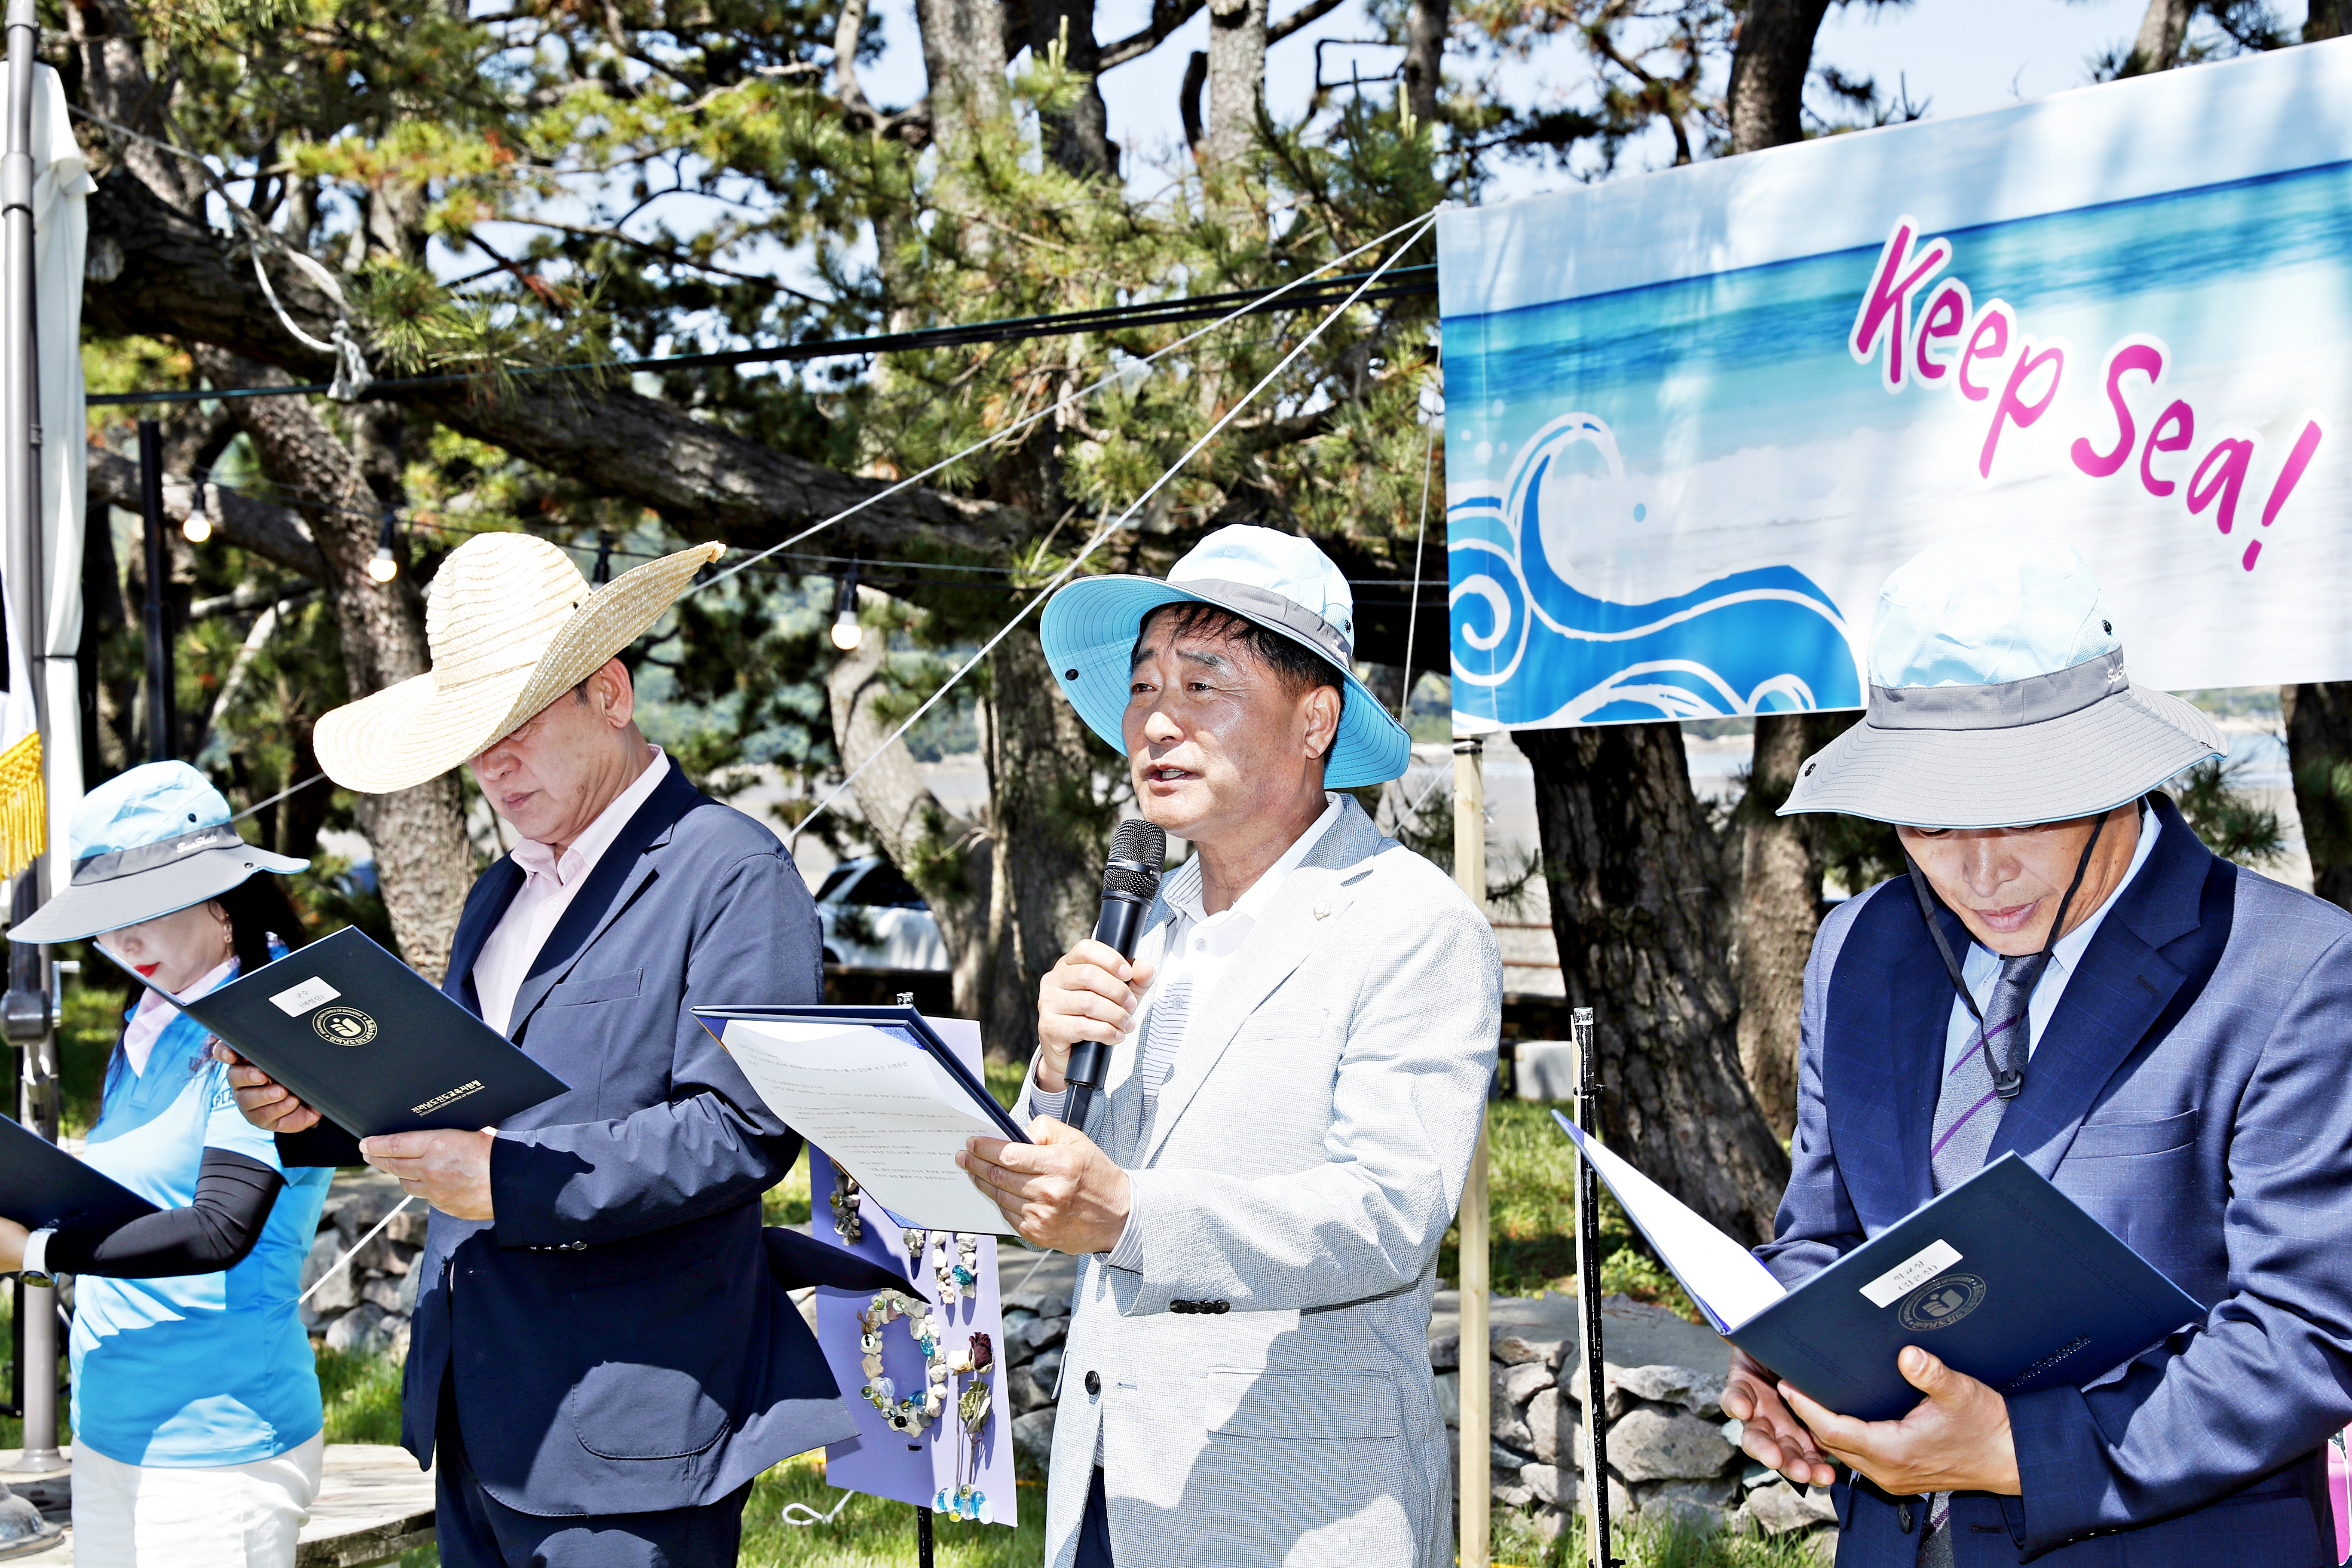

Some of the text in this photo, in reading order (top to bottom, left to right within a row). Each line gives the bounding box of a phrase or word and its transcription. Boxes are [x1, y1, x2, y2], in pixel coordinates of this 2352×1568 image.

[1856, 224, 2323, 572] Keep Sea!
[295, 990, 309, 998] 군수
[411, 1080, 482, 1114] 전라남도진도교육지원청
